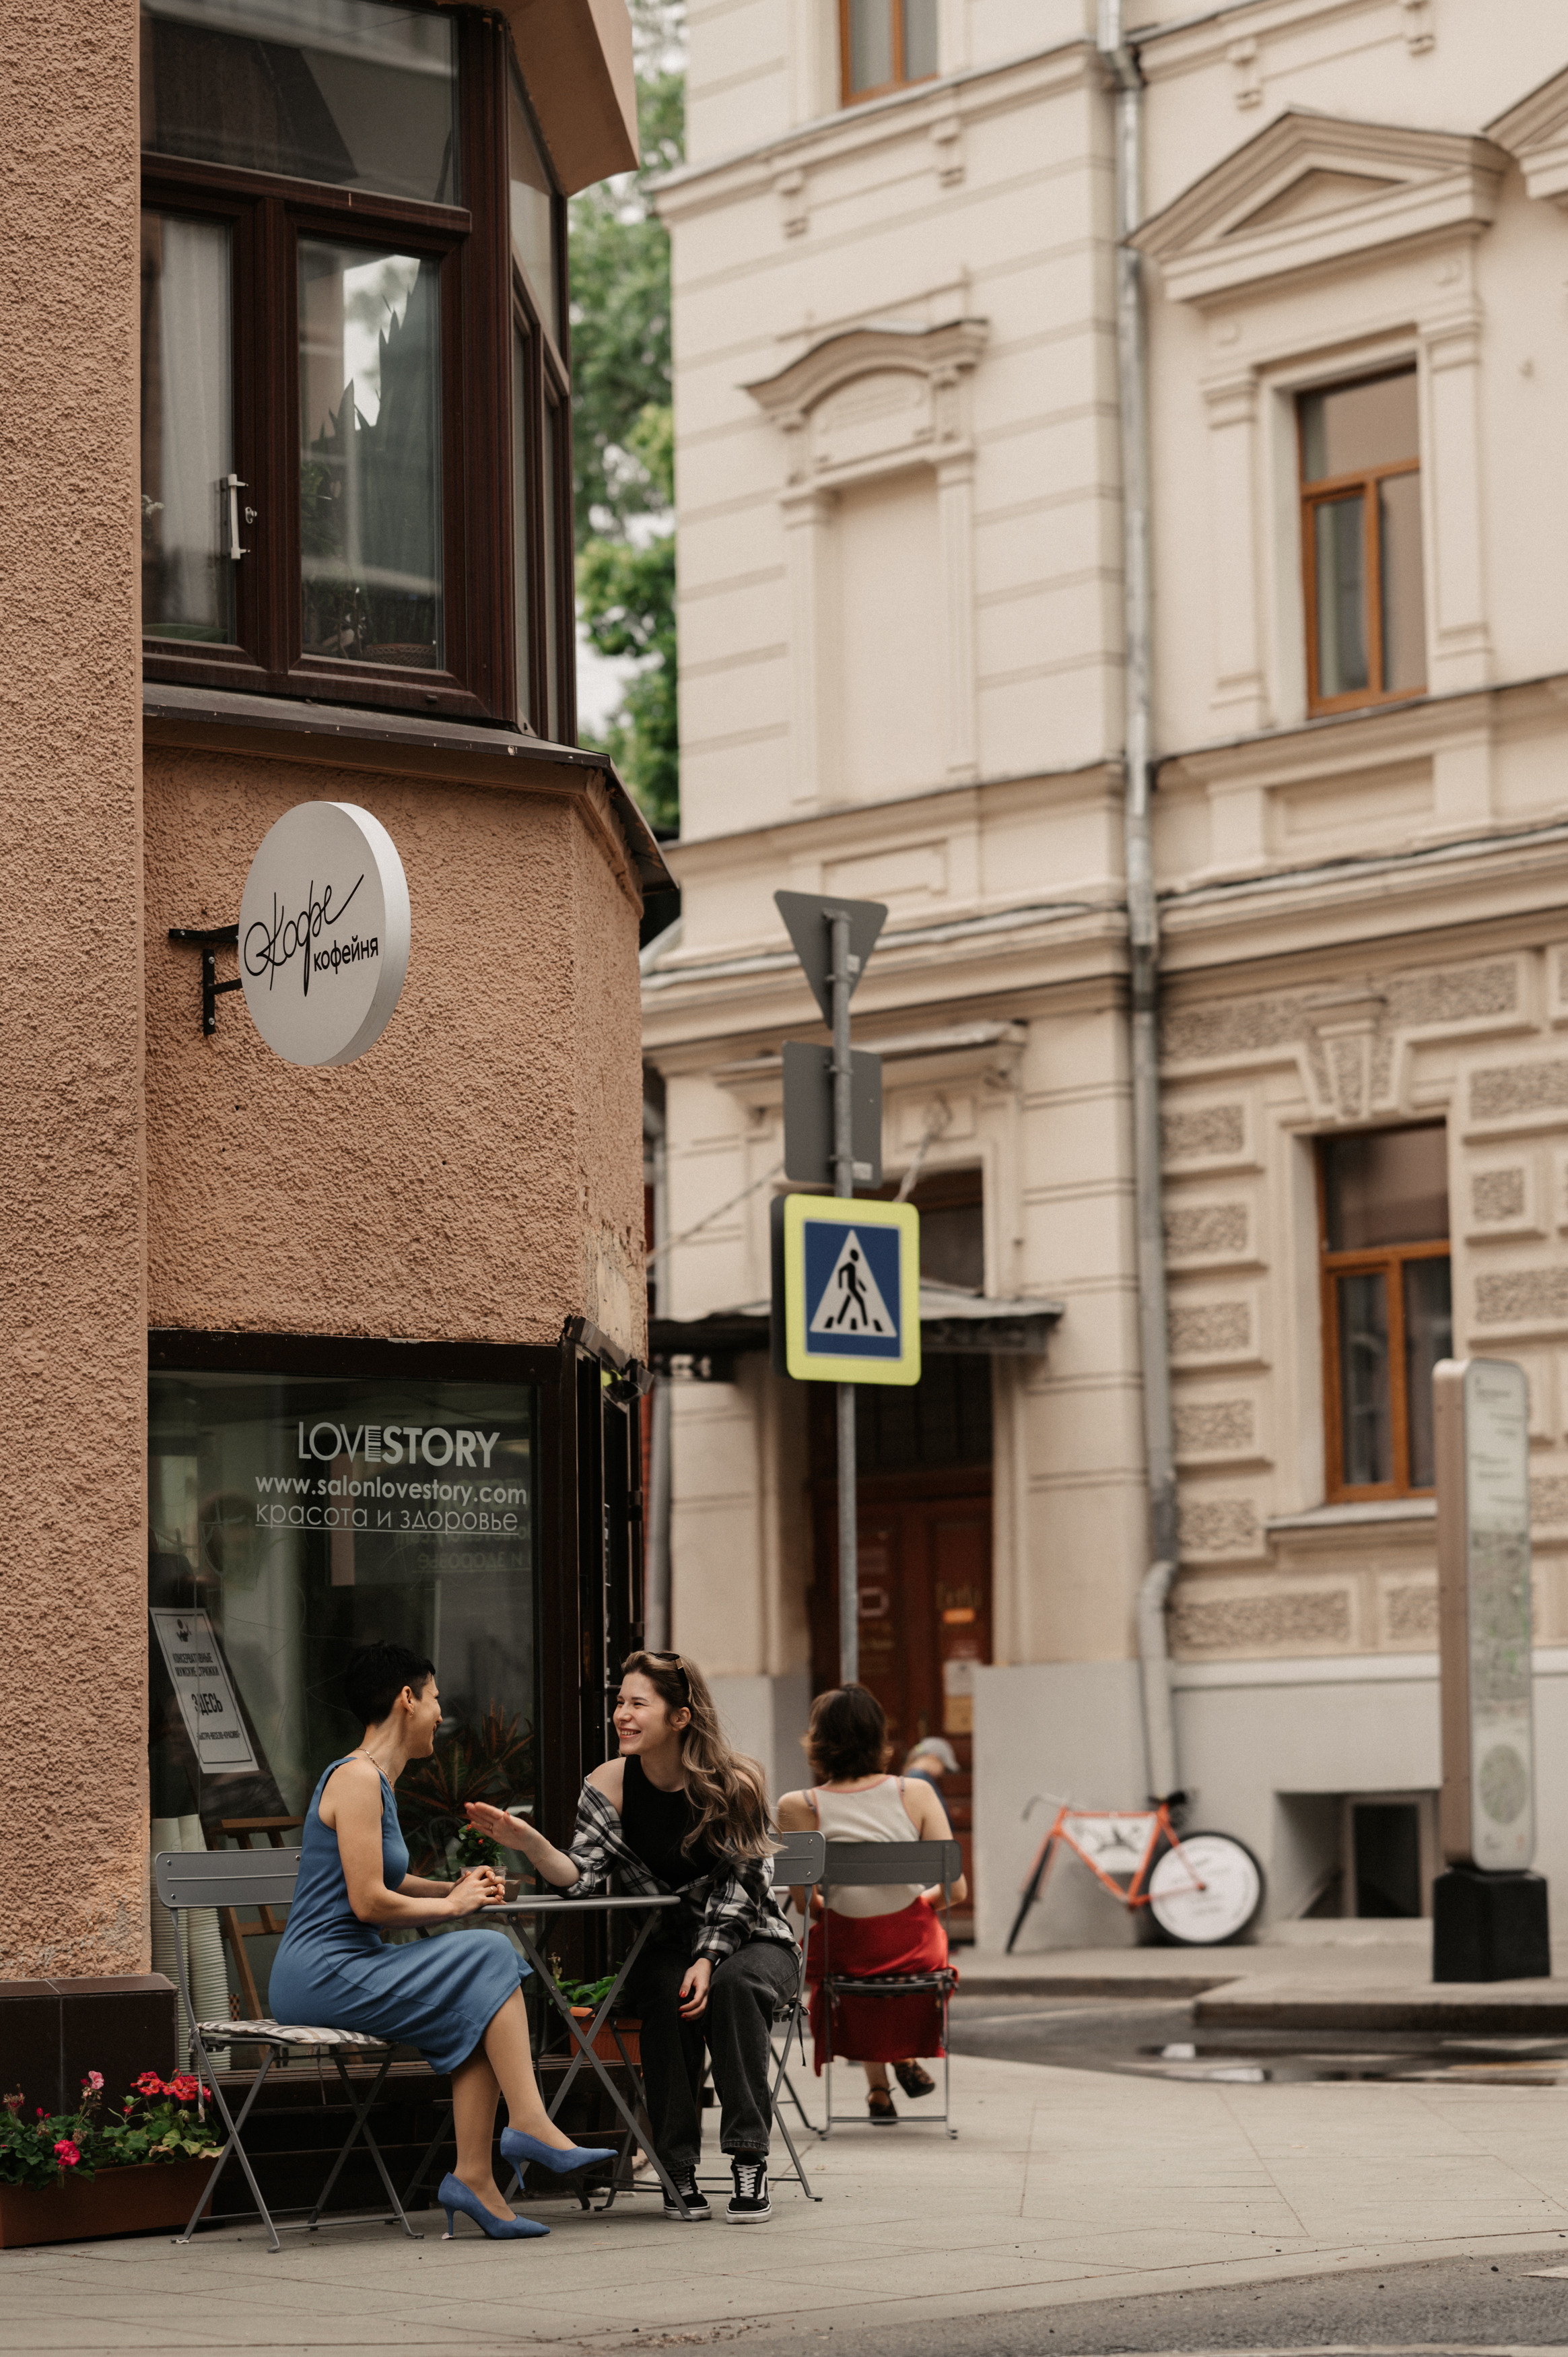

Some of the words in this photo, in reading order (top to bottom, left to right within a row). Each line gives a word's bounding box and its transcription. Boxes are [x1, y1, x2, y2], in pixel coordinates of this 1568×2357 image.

[314, 935, 378, 975] кофейня
[298, 1422, 500, 1468] LOVESTORY
[255, 1475, 527, 1506] www.salonlovestory.com
[257, 1504, 368, 1529] красота
[378, 1509, 391, 1528] и
[400, 1509, 518, 1535] здоровье
[172, 1653, 213, 1663] КОНСЕРВАТВНЫЕ
[191, 1693, 224, 1716] ЗДЕСЬ
